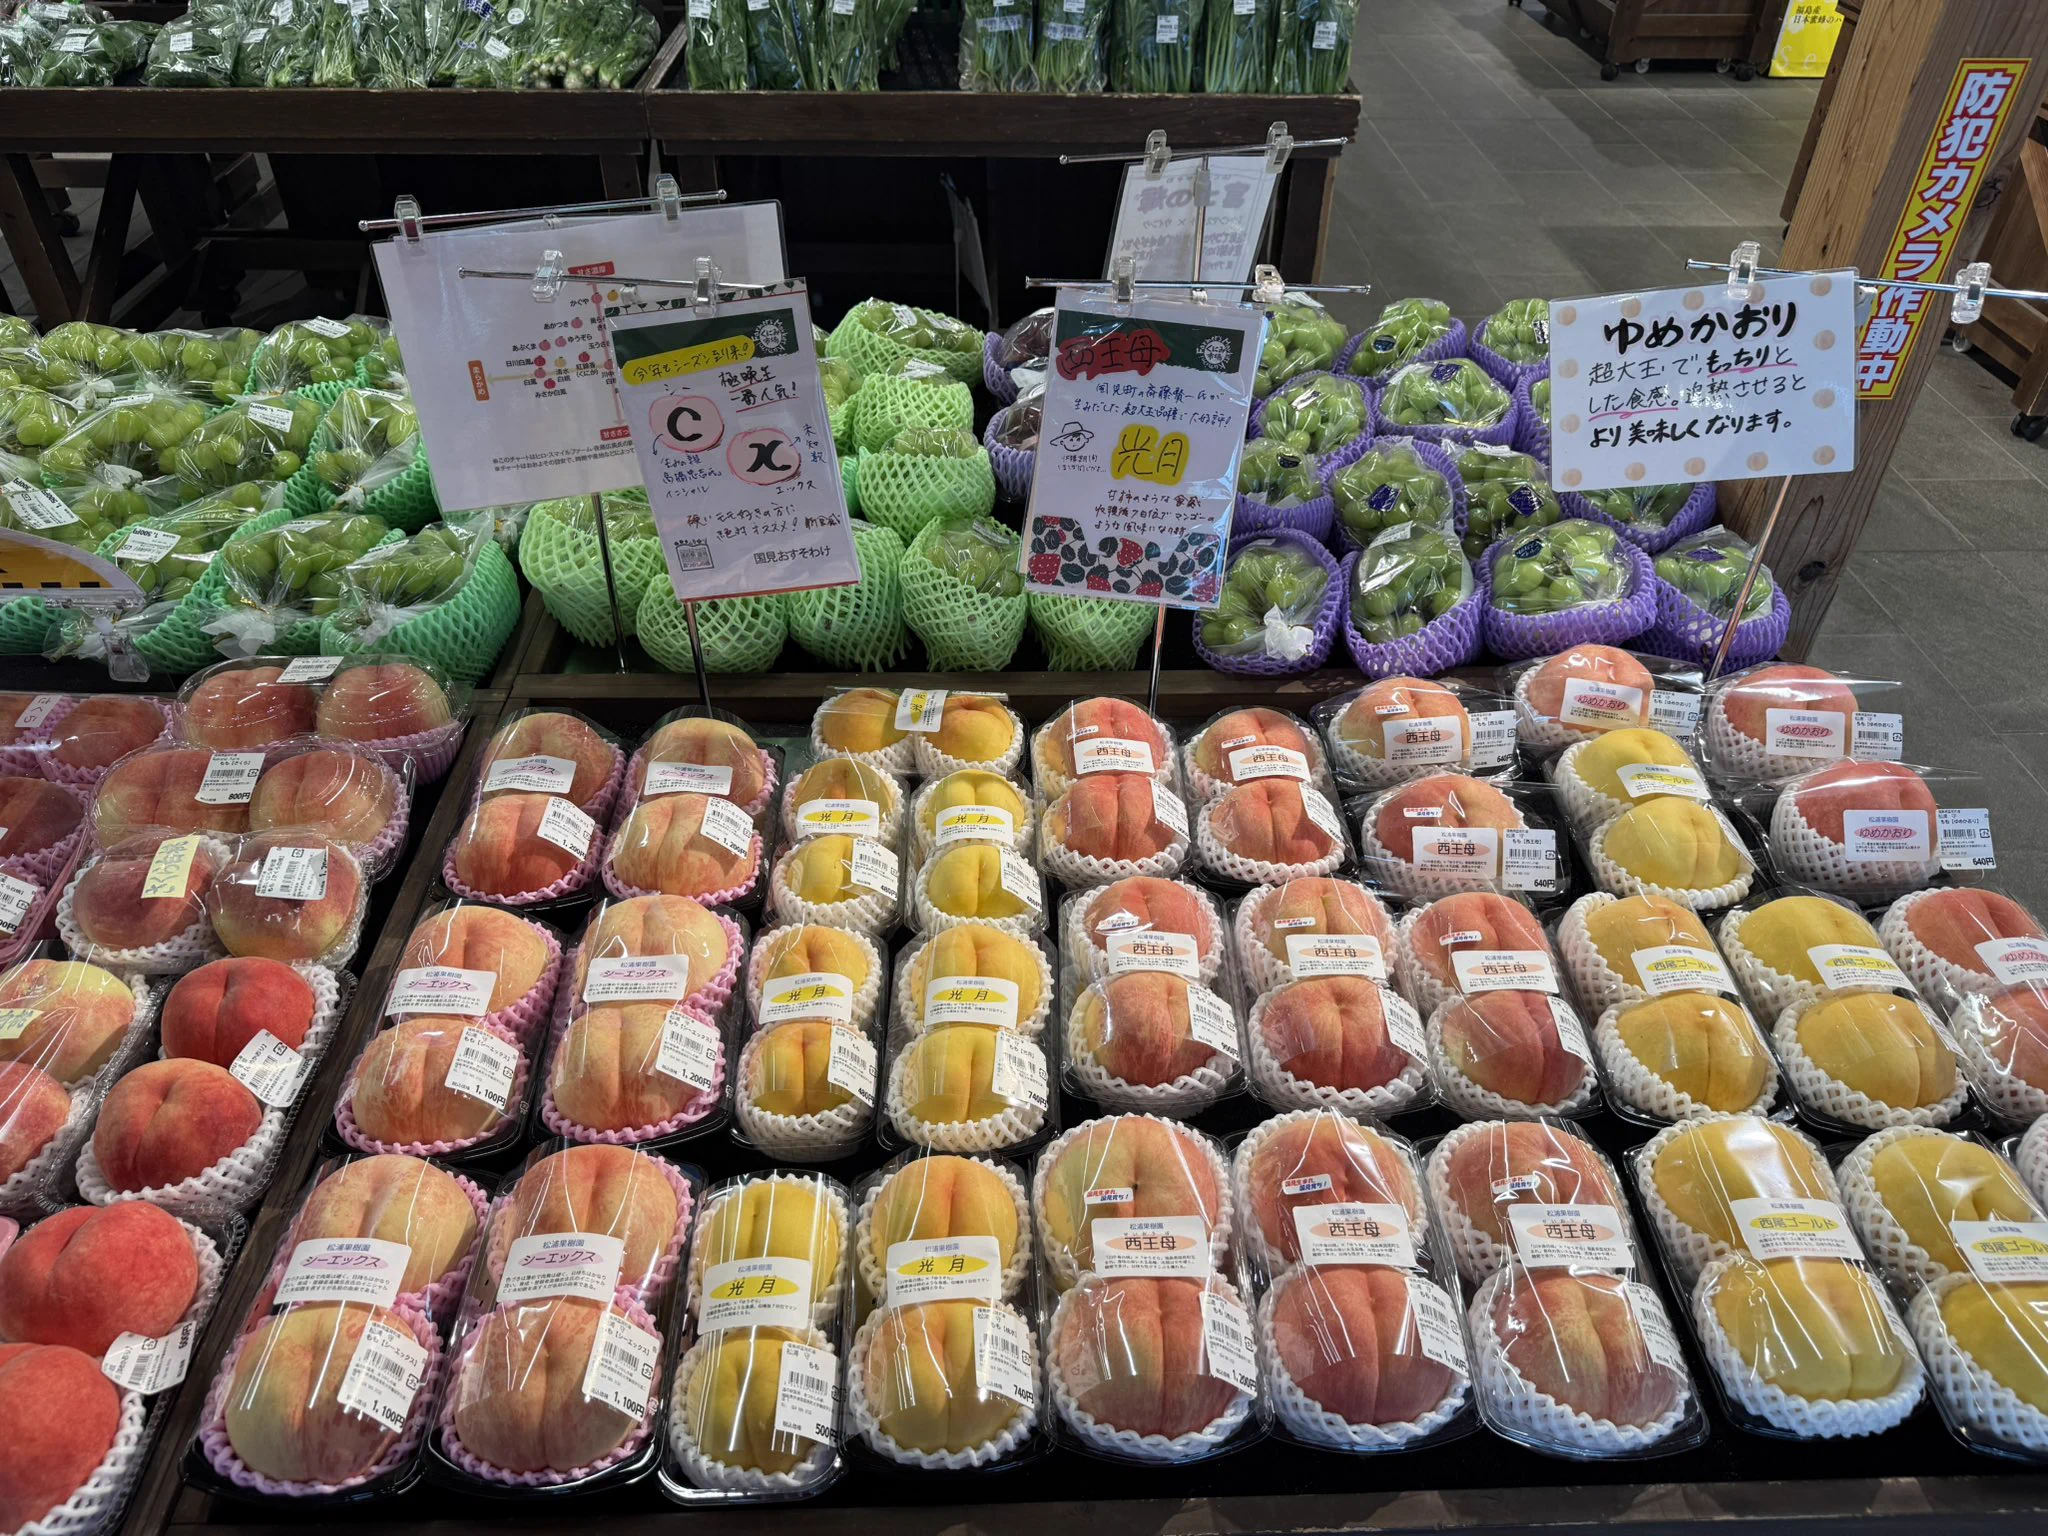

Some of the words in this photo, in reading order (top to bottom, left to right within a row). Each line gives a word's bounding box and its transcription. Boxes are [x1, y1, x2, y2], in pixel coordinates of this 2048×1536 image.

[1859, 70, 2014, 391] 防犯カメラ作動中
[570, 298, 590, 306] かぐや
[544, 320, 569, 330] あかつき
[1604, 302, 1797, 354] ゆめかおり
[568, 334, 592, 343] ゆうぞら
[512, 344, 536, 352] あぶくま
[1061, 336, 1161, 375] 西王母
[667, 406, 702, 442] C
[1588, 409, 1792, 449] より美味しくなります。
[1118, 428, 1184, 478] 光月
[753, 546, 832, 565] 国見おすそわけ
[1578, 696, 1626, 710] ゆめかおり
[1406, 730, 1440, 744] 西王母
[1780, 726, 1830, 738] ゆめかおり
[1096, 746, 1132, 758] 西王母
[1253, 752, 1290, 764] 西王母
[820, 811, 855, 822] 光月
[955, 814, 989, 824] 光月
[1860, 828, 1913, 838] ゆめかおり
[1438, 842, 1476, 856] 西王母
[1972, 858, 1995, 866] 640円
[1534, 880, 1555, 888] 640円
[1133, 945, 1174, 956] 西王母
[1314, 947, 1357, 958] 西王母
[604, 968, 668, 979] シーエックス
[1482, 964, 1528, 975] 西王母
[408, 978, 472, 992] シーエックス
[787, 987, 826, 1002] 光月
[950, 990, 988, 1001] 光月
[682, 1068, 712, 1089] 1,200円
[475, 1084, 505, 1108] 1,100円
[1130, 1222, 1164, 1230] 松浦果樹園
[1328, 1222, 1380, 1238] 西王母
[1760, 1217, 1834, 1230] 西尾ゴールド
[1544, 1224, 1596, 1240] 西王母
[326, 1243, 370, 1252] 松浦果樹園
[542, 1239, 584, 1249] 松浦果樹園
[1124, 1236, 1176, 1250] 西王母
[304, 1254, 381, 1268] シーエックス
[522, 1250, 596, 1266] シーエックス
[918, 1258, 965, 1274] 光月
[728, 1278, 776, 1297] 光月
[1013, 1384, 1034, 1404] 740円
[614, 1390, 645, 1418] 1,100円
[372, 1399, 405, 1429] 1,100円
[815, 1422, 838, 1442] 500円
